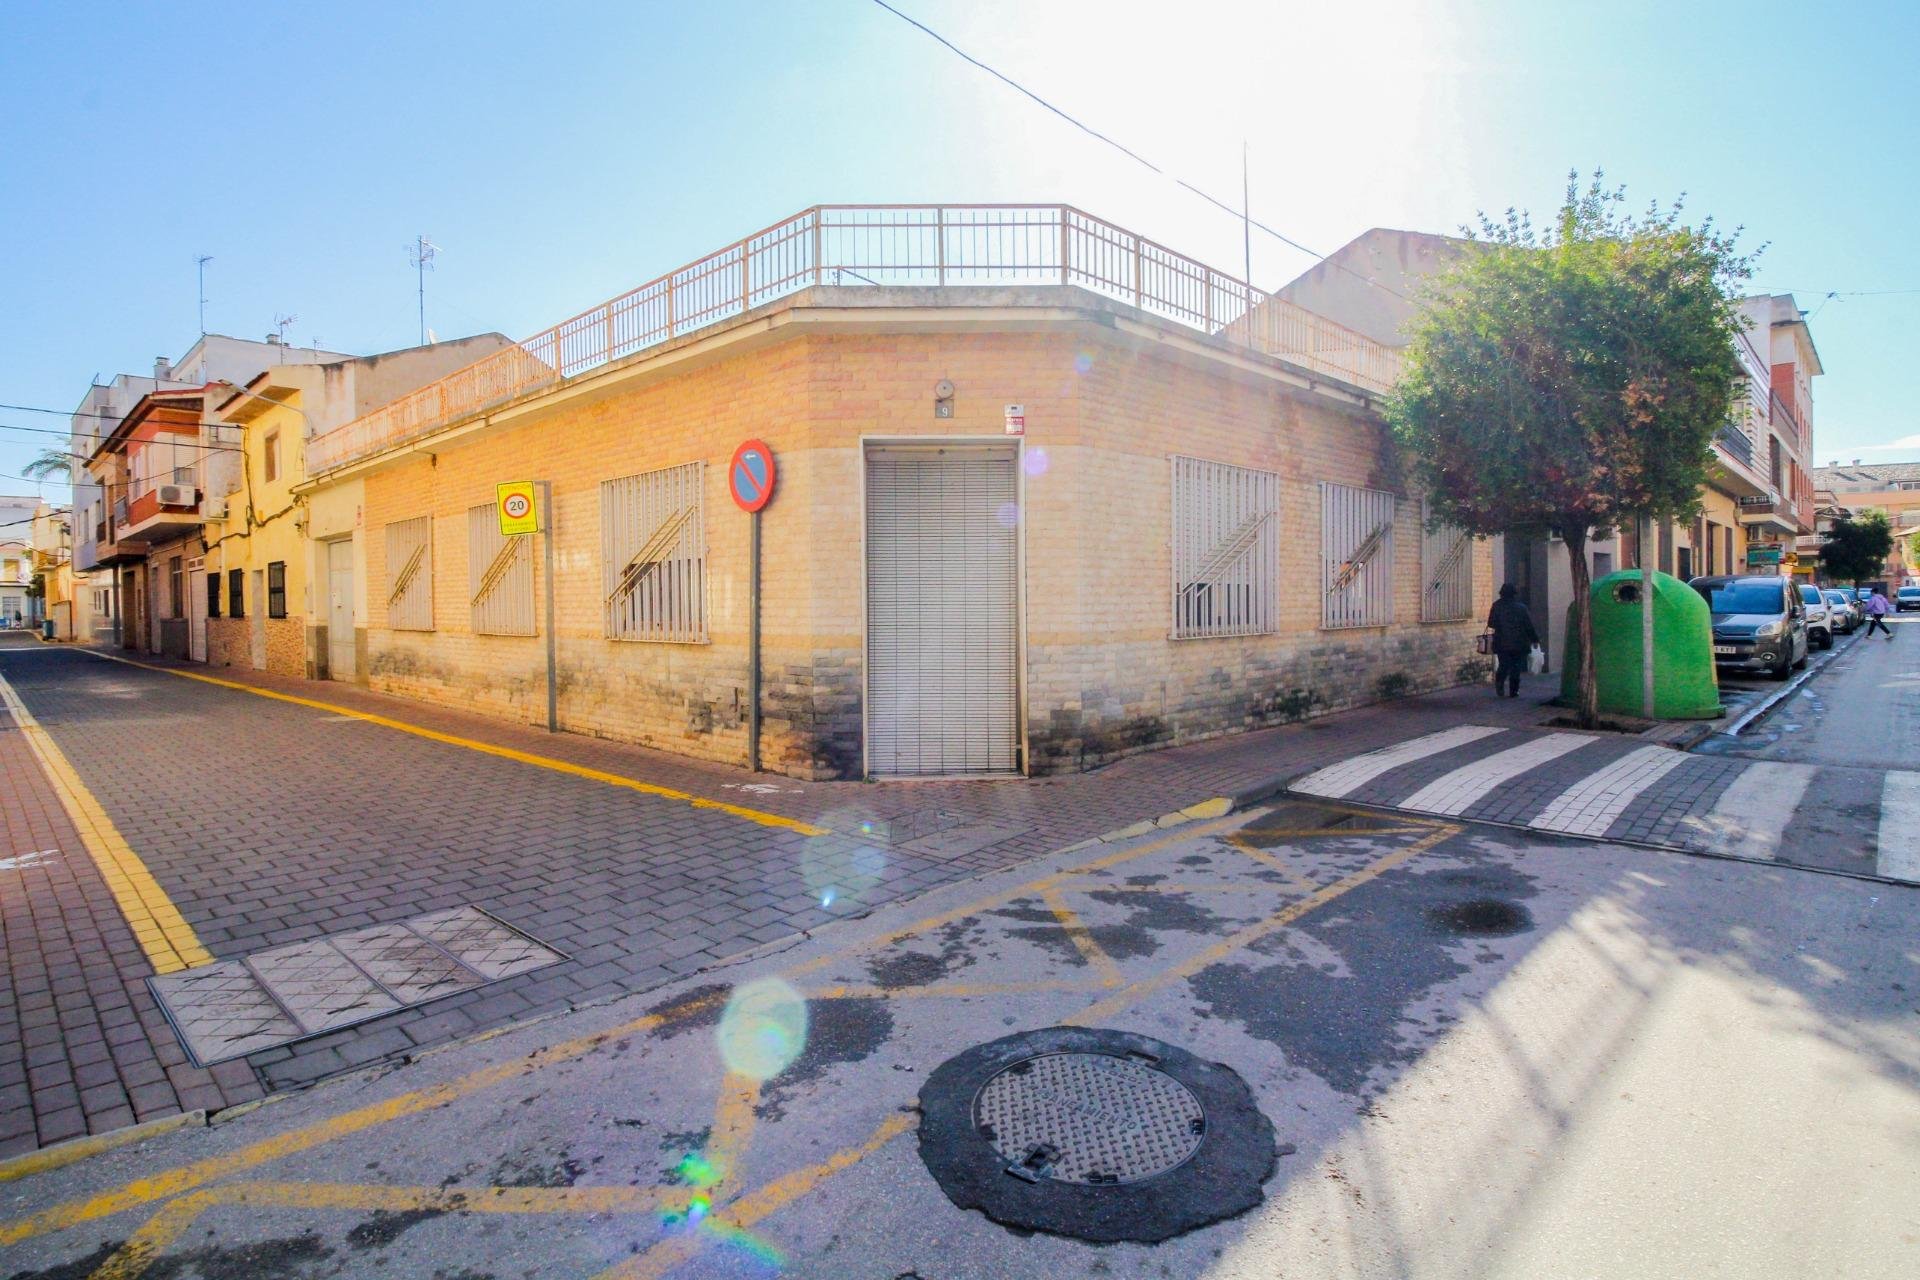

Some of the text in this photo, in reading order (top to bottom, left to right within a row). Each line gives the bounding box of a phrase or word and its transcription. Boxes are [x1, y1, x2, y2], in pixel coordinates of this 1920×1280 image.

[942, 407, 948, 417] 9
[510, 500, 525, 511] 20
[1041, 1090, 1137, 1129] SANEAMIENTO
